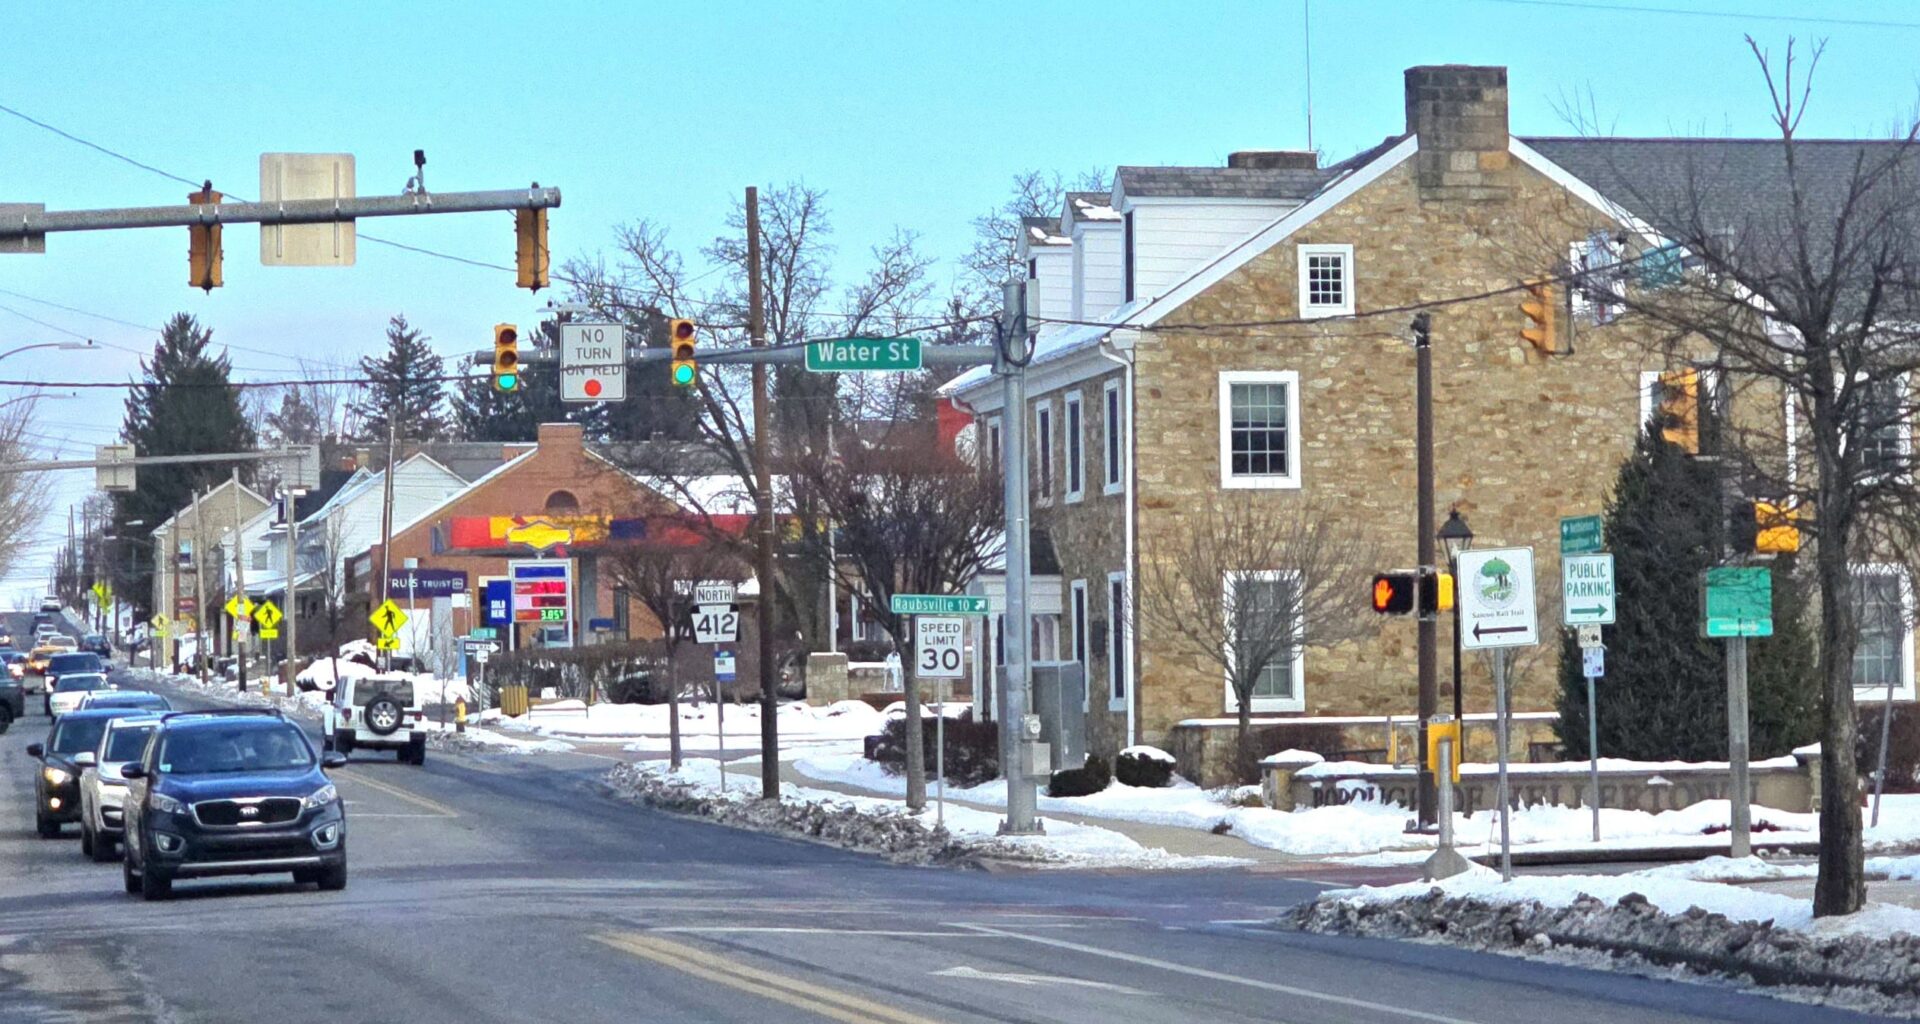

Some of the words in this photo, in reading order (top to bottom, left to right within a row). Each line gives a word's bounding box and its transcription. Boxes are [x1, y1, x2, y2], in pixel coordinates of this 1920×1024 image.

[582, 329, 604, 343] NO
[576, 347, 612, 359] TURN
[818, 342, 880, 361] Water
[888, 342, 910, 361] St
[566, 364, 585, 376] ON
[593, 363, 621, 376] RED
[1569, 562, 1607, 579] PUBLIC
[1566, 580, 1611, 597] PARKING
[698, 590, 731, 601] NORTH
[895, 598, 954, 611] Raubsville
[959, 599, 970, 611] 10
[1511, 608, 1525, 617] Trail
[697, 614, 736, 635] 412
[921, 623, 960, 633] SPEED
[925, 636, 956, 646] LIMIT
[922, 648, 960, 670] 30
